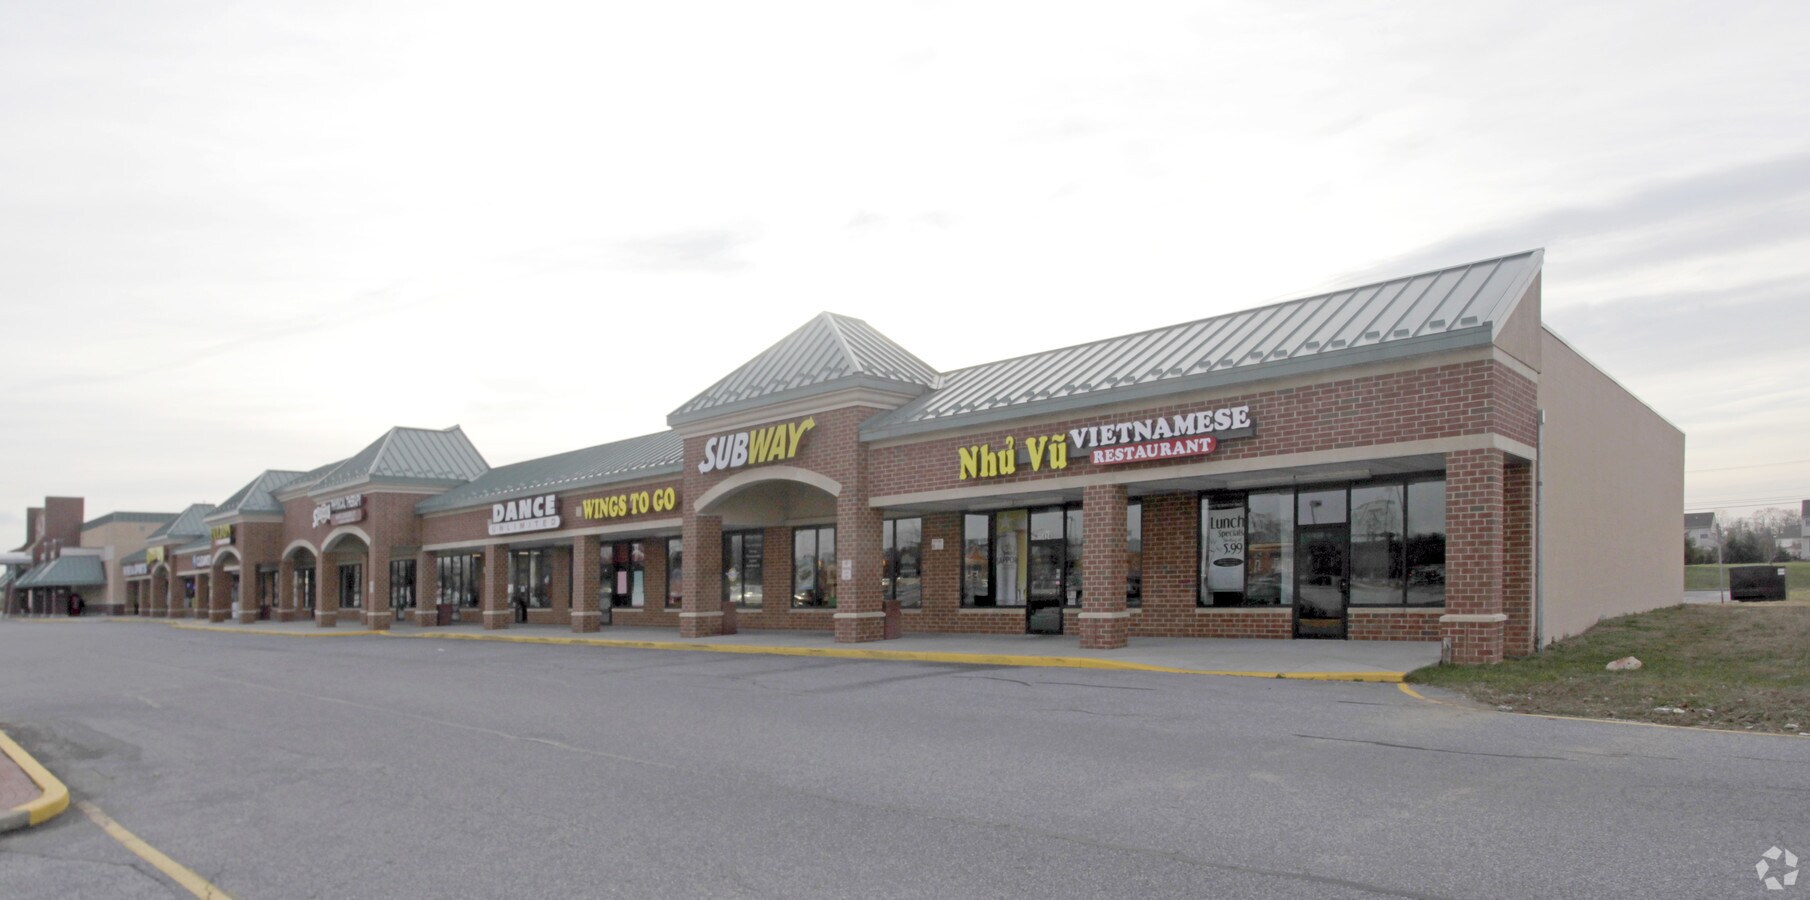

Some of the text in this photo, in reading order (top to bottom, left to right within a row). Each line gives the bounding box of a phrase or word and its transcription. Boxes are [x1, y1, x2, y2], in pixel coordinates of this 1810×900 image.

[1070, 406, 1250, 449] VIETNAMESE
[698, 416, 815, 474] SUBWAY
[1025, 434, 1067, 472] Vũ
[1093, 437, 1212, 465] RESTAURANT
[493, 494, 556, 523] DANCE
[583, 487, 675, 520] WINGS TO GO
[491, 518, 556, 534] UNLIMITED
[1210, 515, 1244, 529] Lunch
[1223, 543, 1243, 555] 5.99
